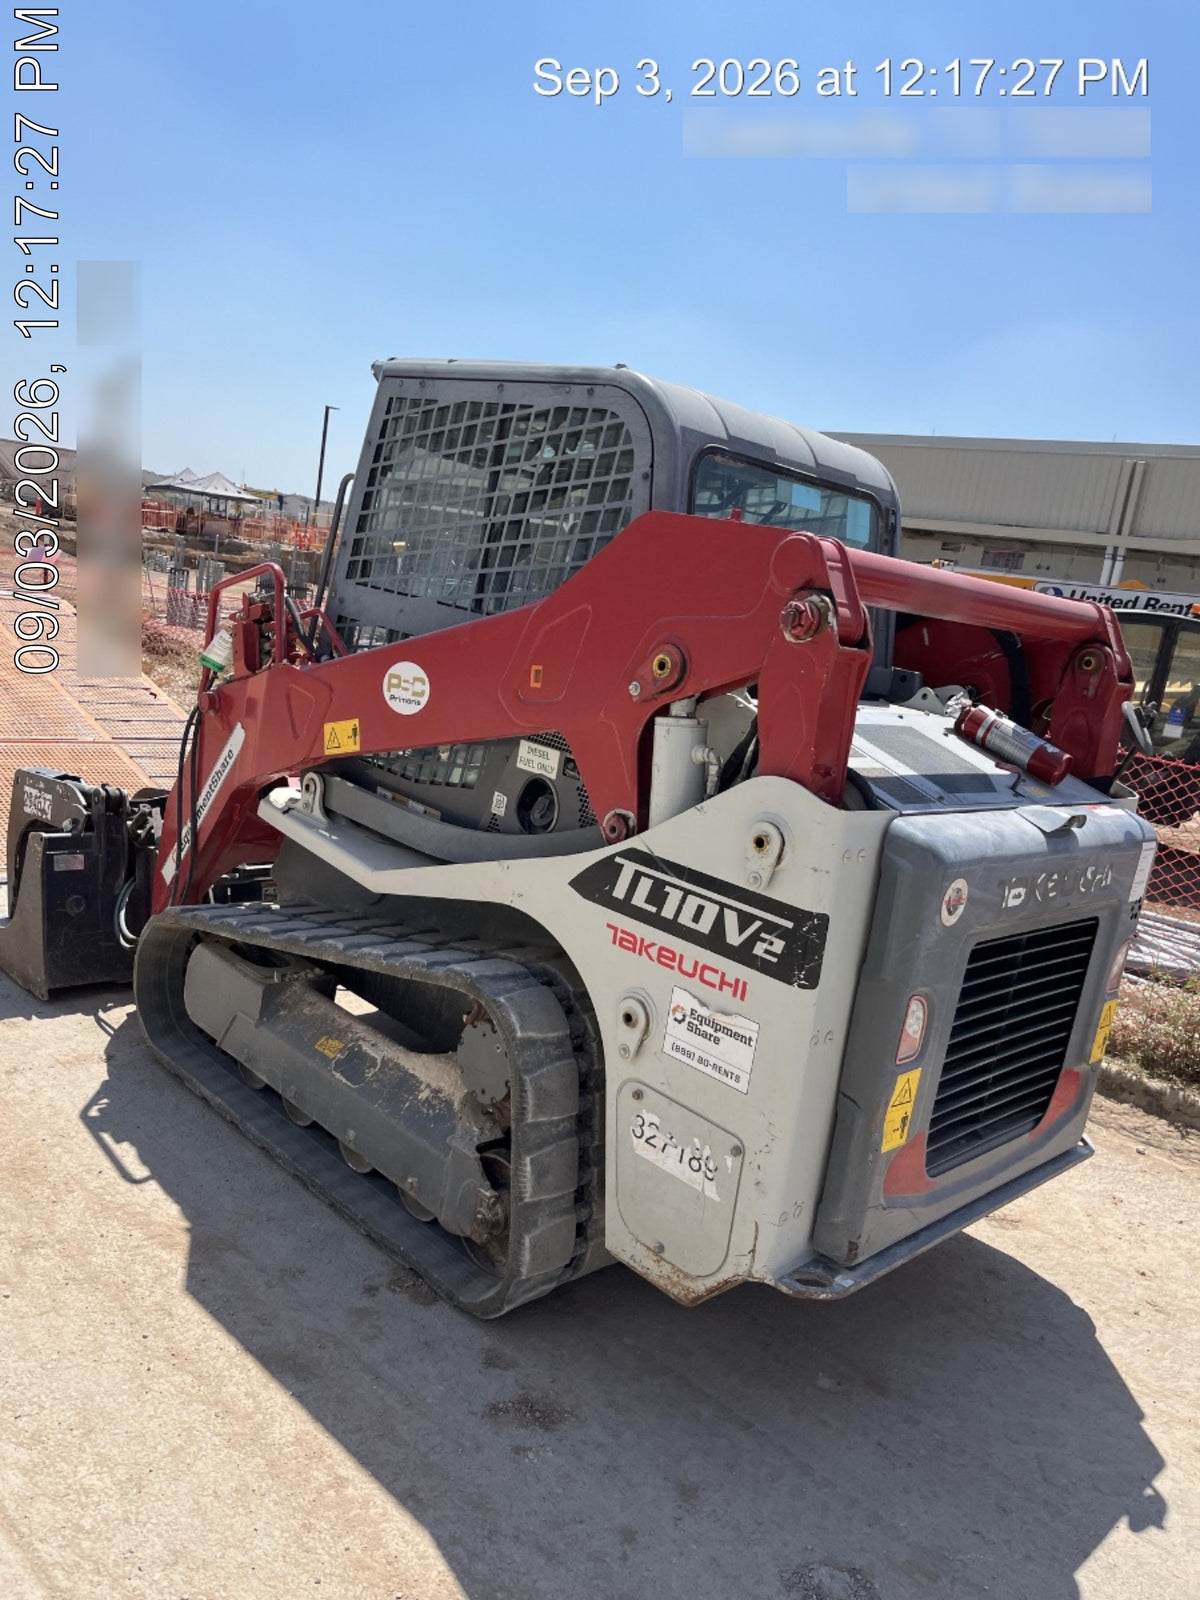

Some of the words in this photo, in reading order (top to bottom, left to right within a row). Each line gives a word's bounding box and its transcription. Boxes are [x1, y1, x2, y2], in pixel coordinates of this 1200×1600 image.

[519, 755, 535, 769] FUEL
[536, 762, 556, 774] ONLY
[527, 745, 550, 761] DIESEL
[611, 856, 794, 963] TL10V2
[686, 1020, 721, 1045] Share
[689, 1007, 753, 1047] Equipment
[697, 1055, 741, 1084] 80-RENTS
